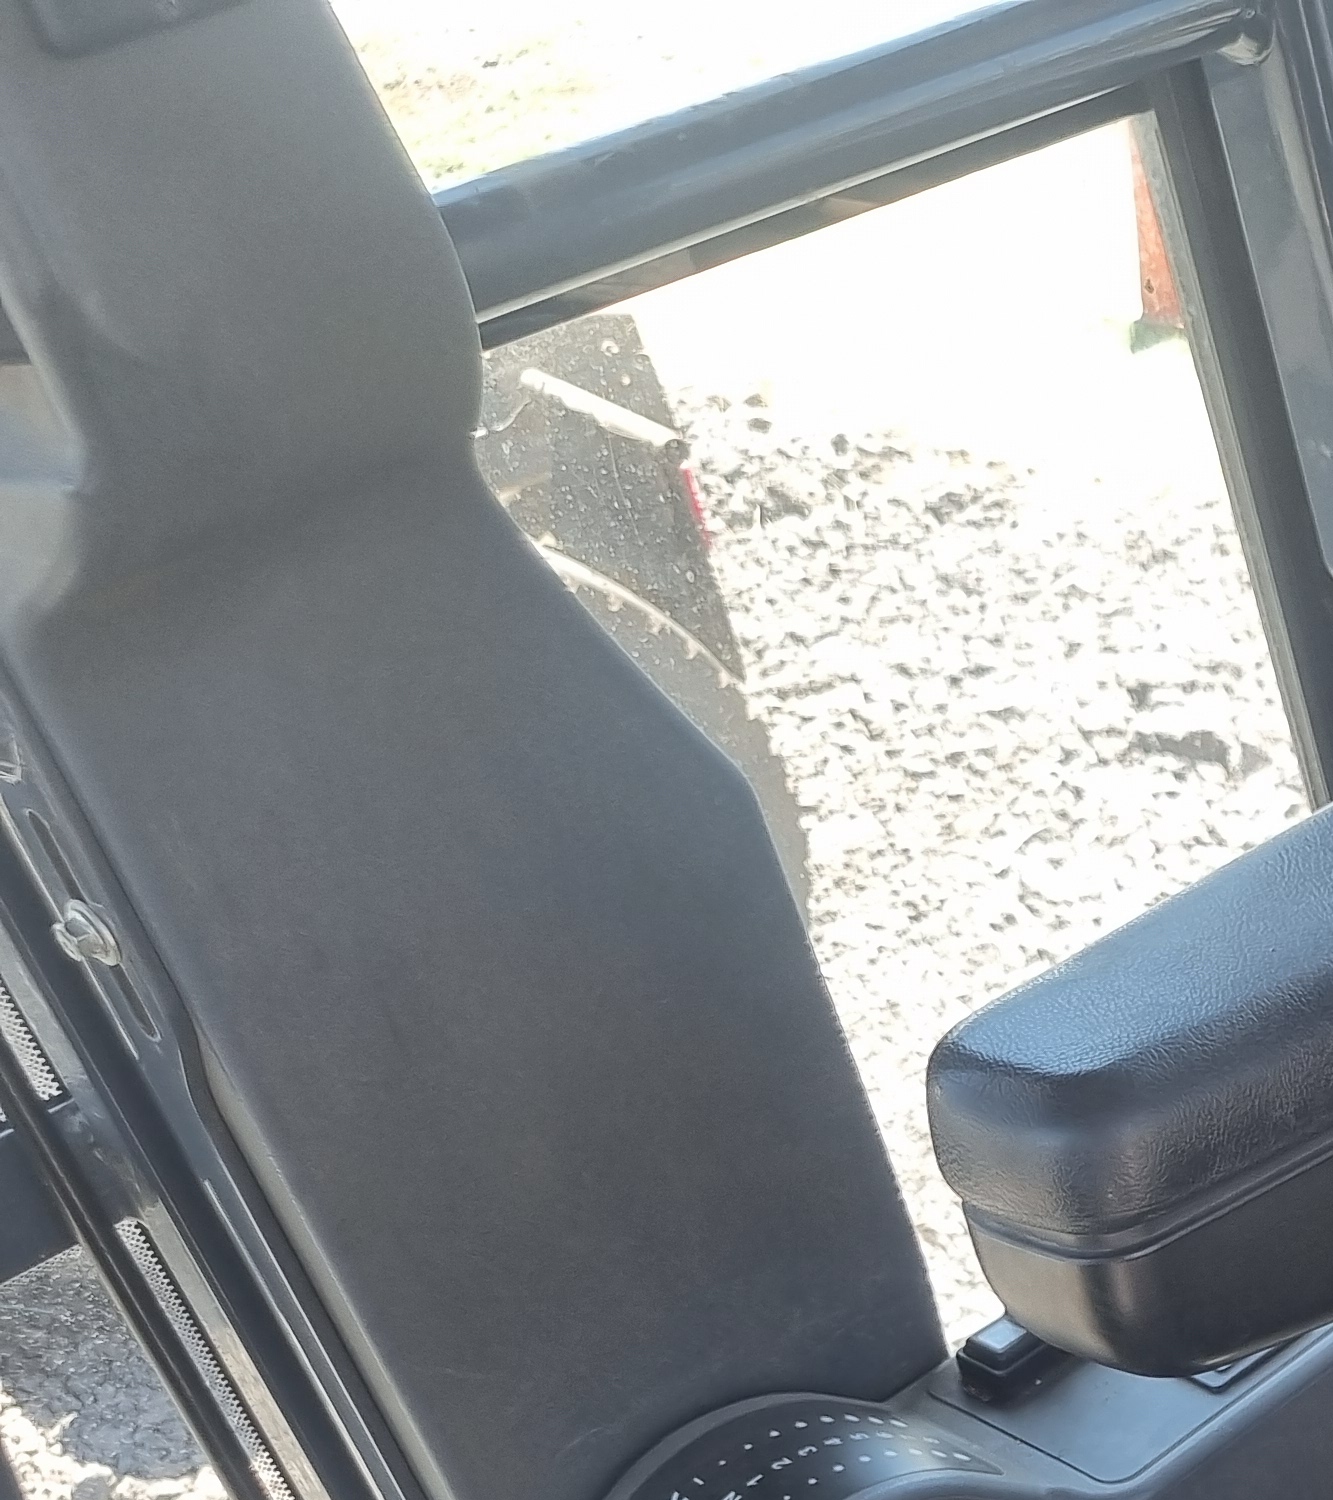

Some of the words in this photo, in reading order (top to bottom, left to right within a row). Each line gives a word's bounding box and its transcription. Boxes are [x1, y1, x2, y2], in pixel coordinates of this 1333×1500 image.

[746, 1474, 763, 1486] 1
[771, 1457, 793, 1470] 2
[798, 1446, 818, 1456] 3
